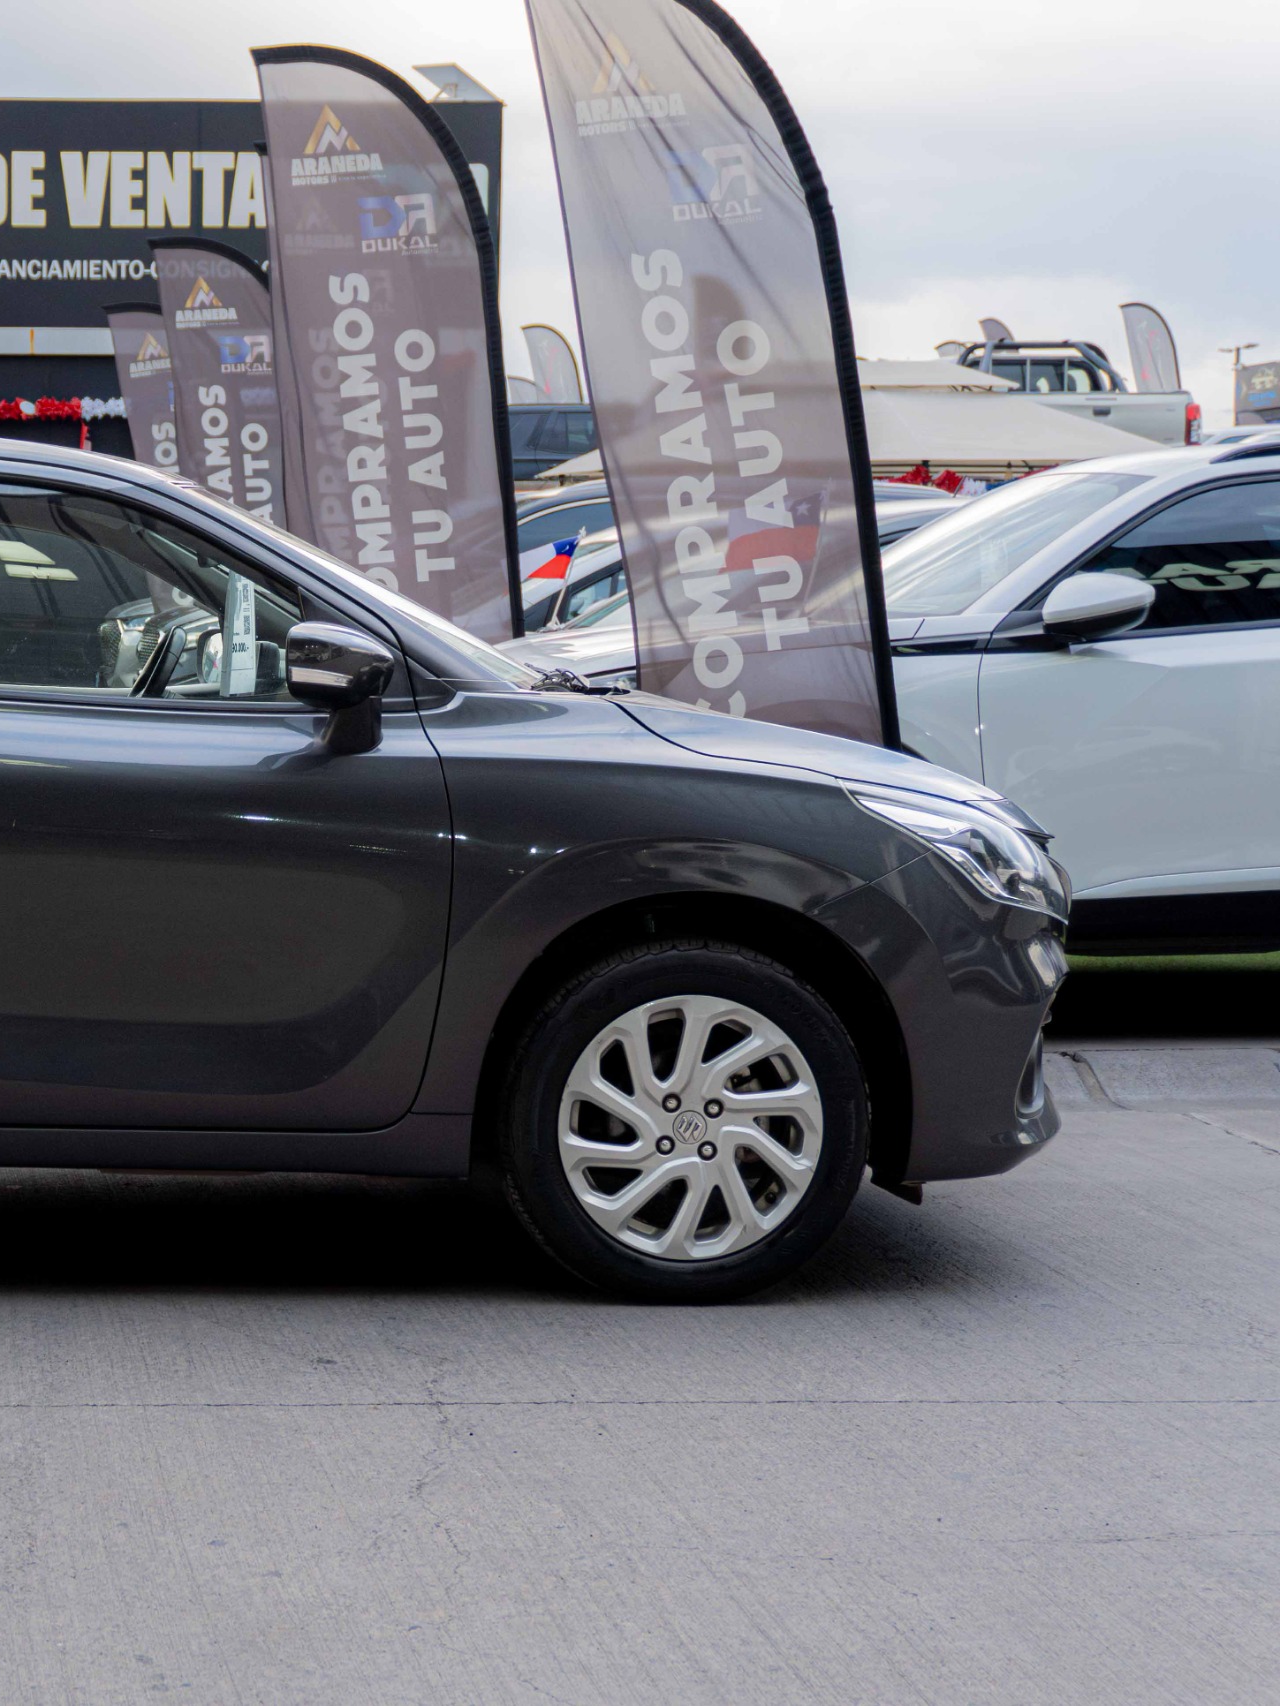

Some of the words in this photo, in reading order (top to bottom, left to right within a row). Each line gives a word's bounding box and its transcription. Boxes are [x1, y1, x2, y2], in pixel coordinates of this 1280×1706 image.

[576, 93, 687, 125] ARANEDA
[291, 153, 383, 177] ARANEDA
[60, 150, 266, 230] VENTA
[292, 175, 329, 187] MOTORS
[672, 198, 762, 222] DUKAL
[361, 235, 438, 254] DUKAL
[175, 307, 239, 323] ARANEDA
[221, 362, 272, 374] DUKAL
[394, 329, 448, 490] AUTO
[717, 320, 794, 528] AUTO
[411, 509, 456, 582] TU
[752, 555, 808, 651] TU
